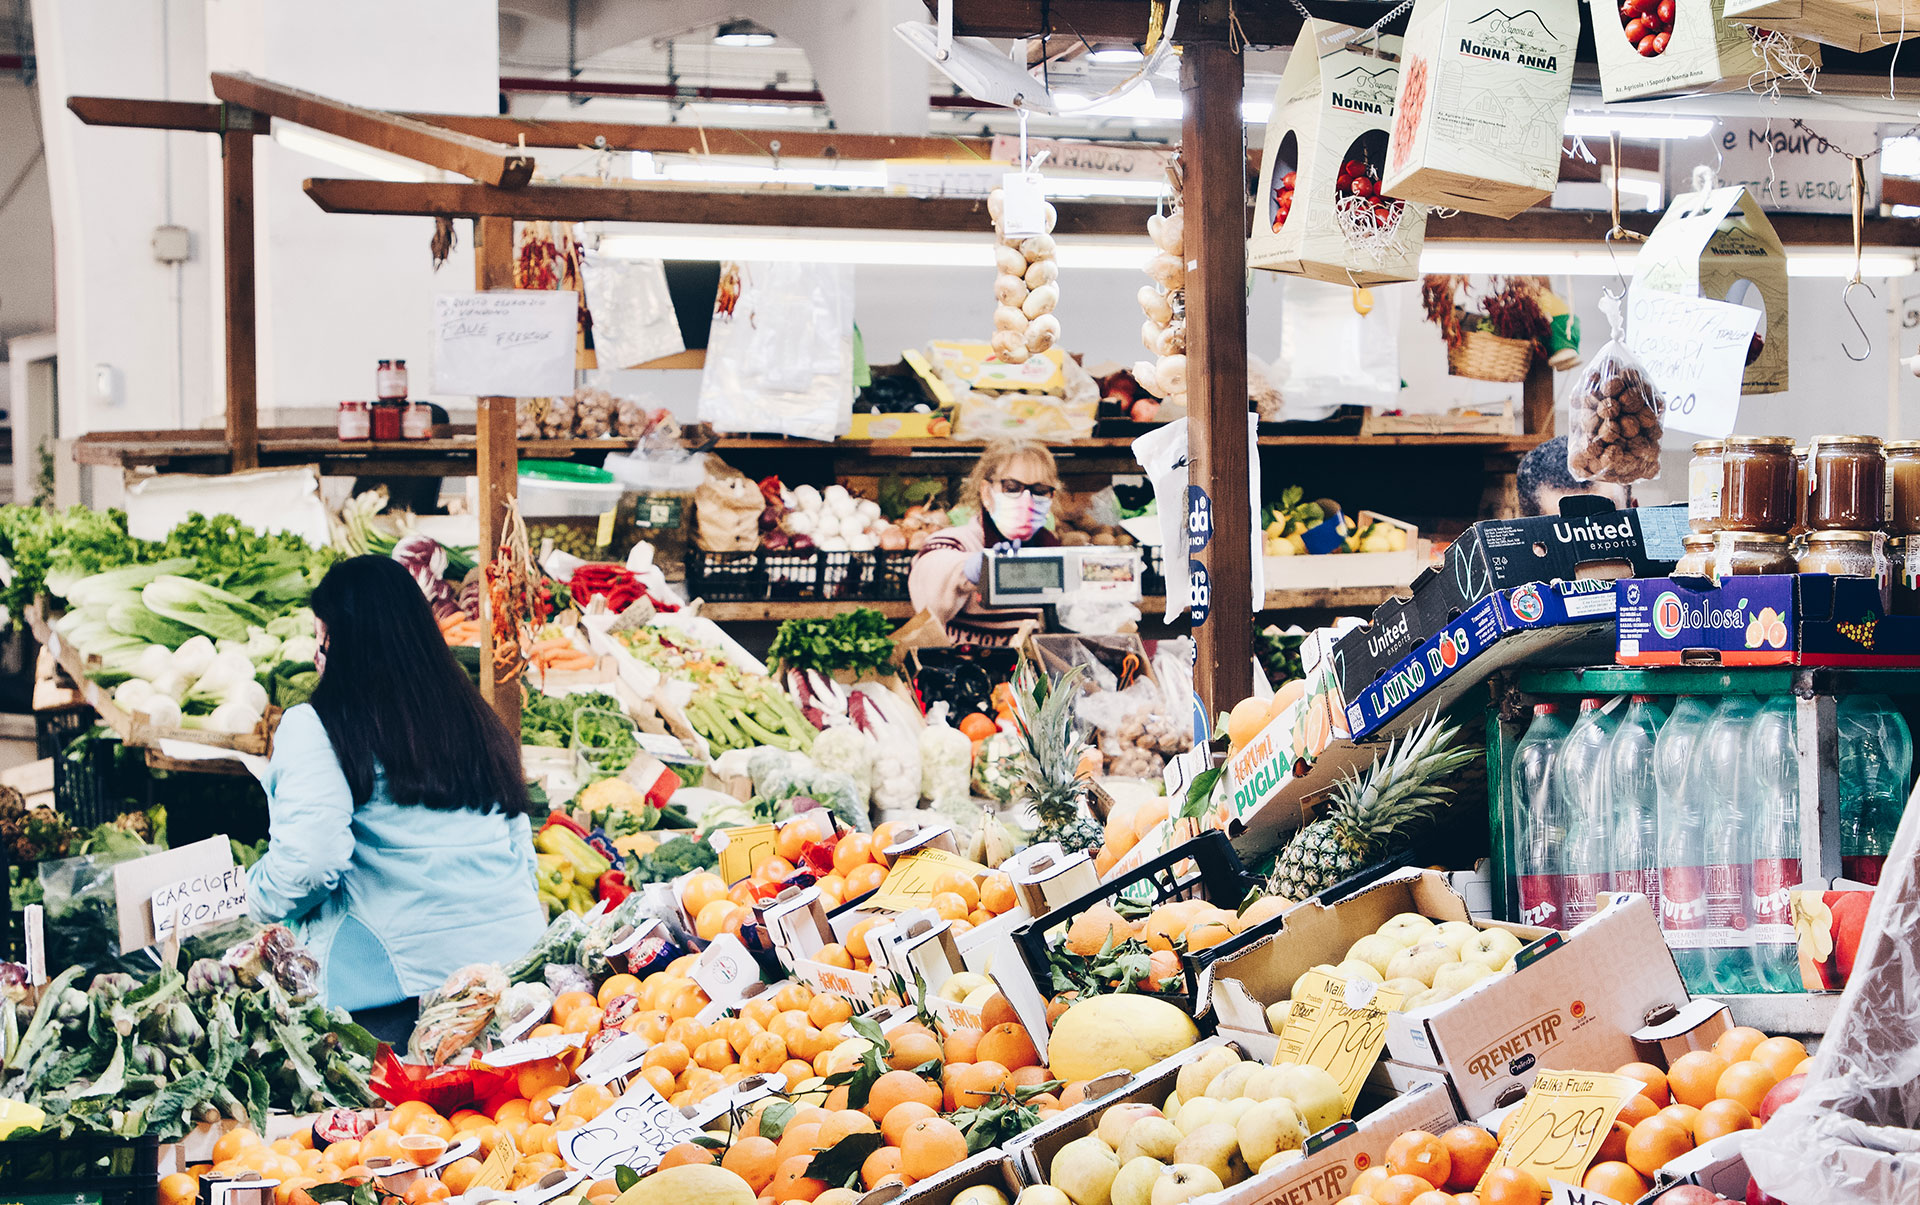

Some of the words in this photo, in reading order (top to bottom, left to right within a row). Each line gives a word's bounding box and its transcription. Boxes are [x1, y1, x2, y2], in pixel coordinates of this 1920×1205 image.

[1750, 128, 1829, 155] Mauro
[1796, 180, 1872, 201] VERDUA
[1553, 516, 1634, 544] United
[1590, 539, 1638, 552] exports
[1367, 611, 1410, 658] United
[1386, 632, 1412, 657] exports
[1370, 660, 1427, 719] LATINO
[1234, 750, 1292, 818] PUGLIA
[156, 867, 239, 907] CARCIOFI
[1468, 1013, 1563, 1082] RENETTA
[1564, 1078, 1594, 1092] Frutta
